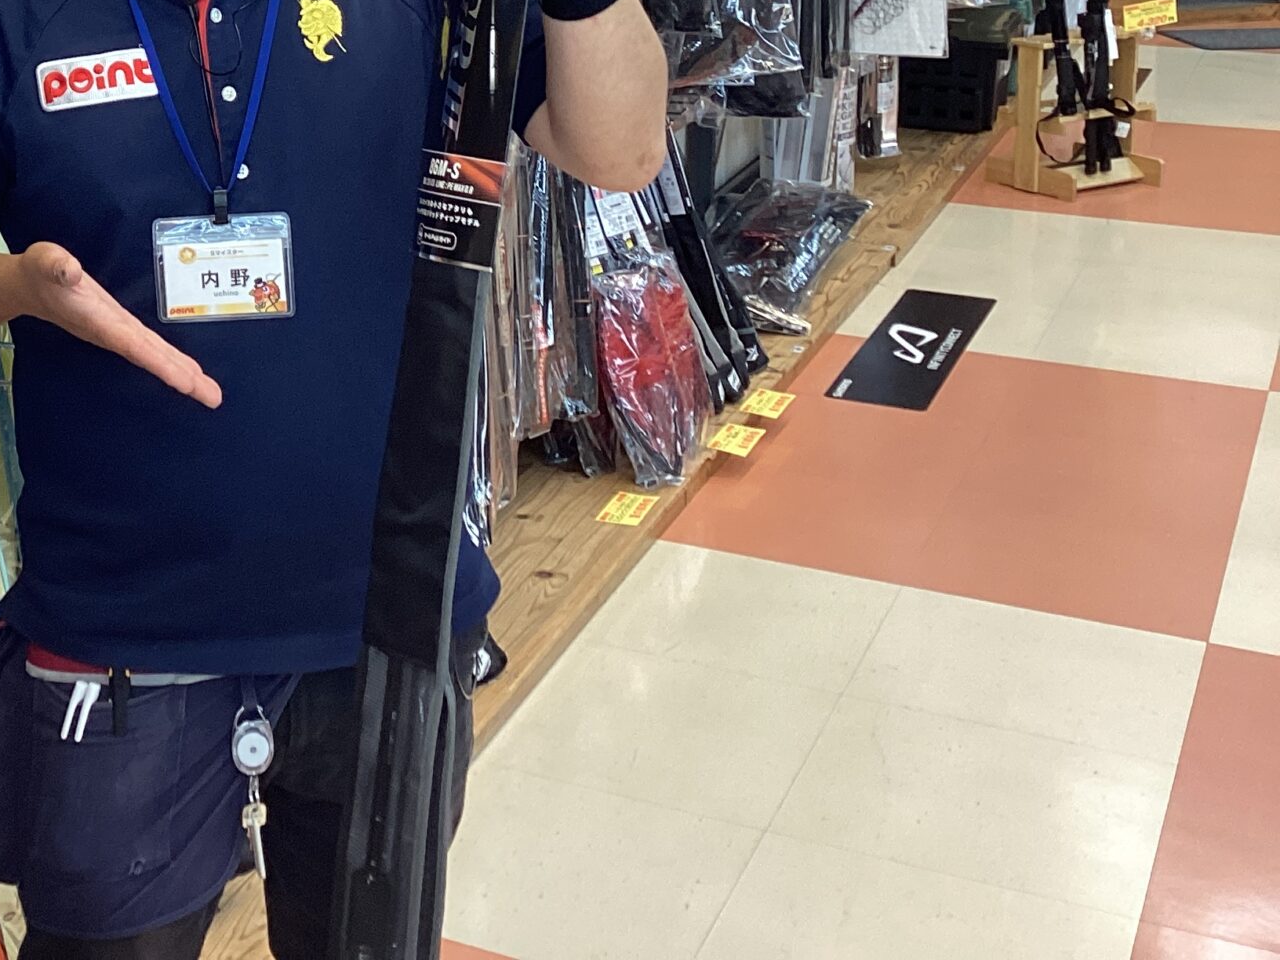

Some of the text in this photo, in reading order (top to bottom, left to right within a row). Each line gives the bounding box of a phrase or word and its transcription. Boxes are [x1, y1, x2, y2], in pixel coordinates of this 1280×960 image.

[43, 58, 155, 105] point
[201, 268, 250, 289] 内野
[169, 306, 196, 316] point
